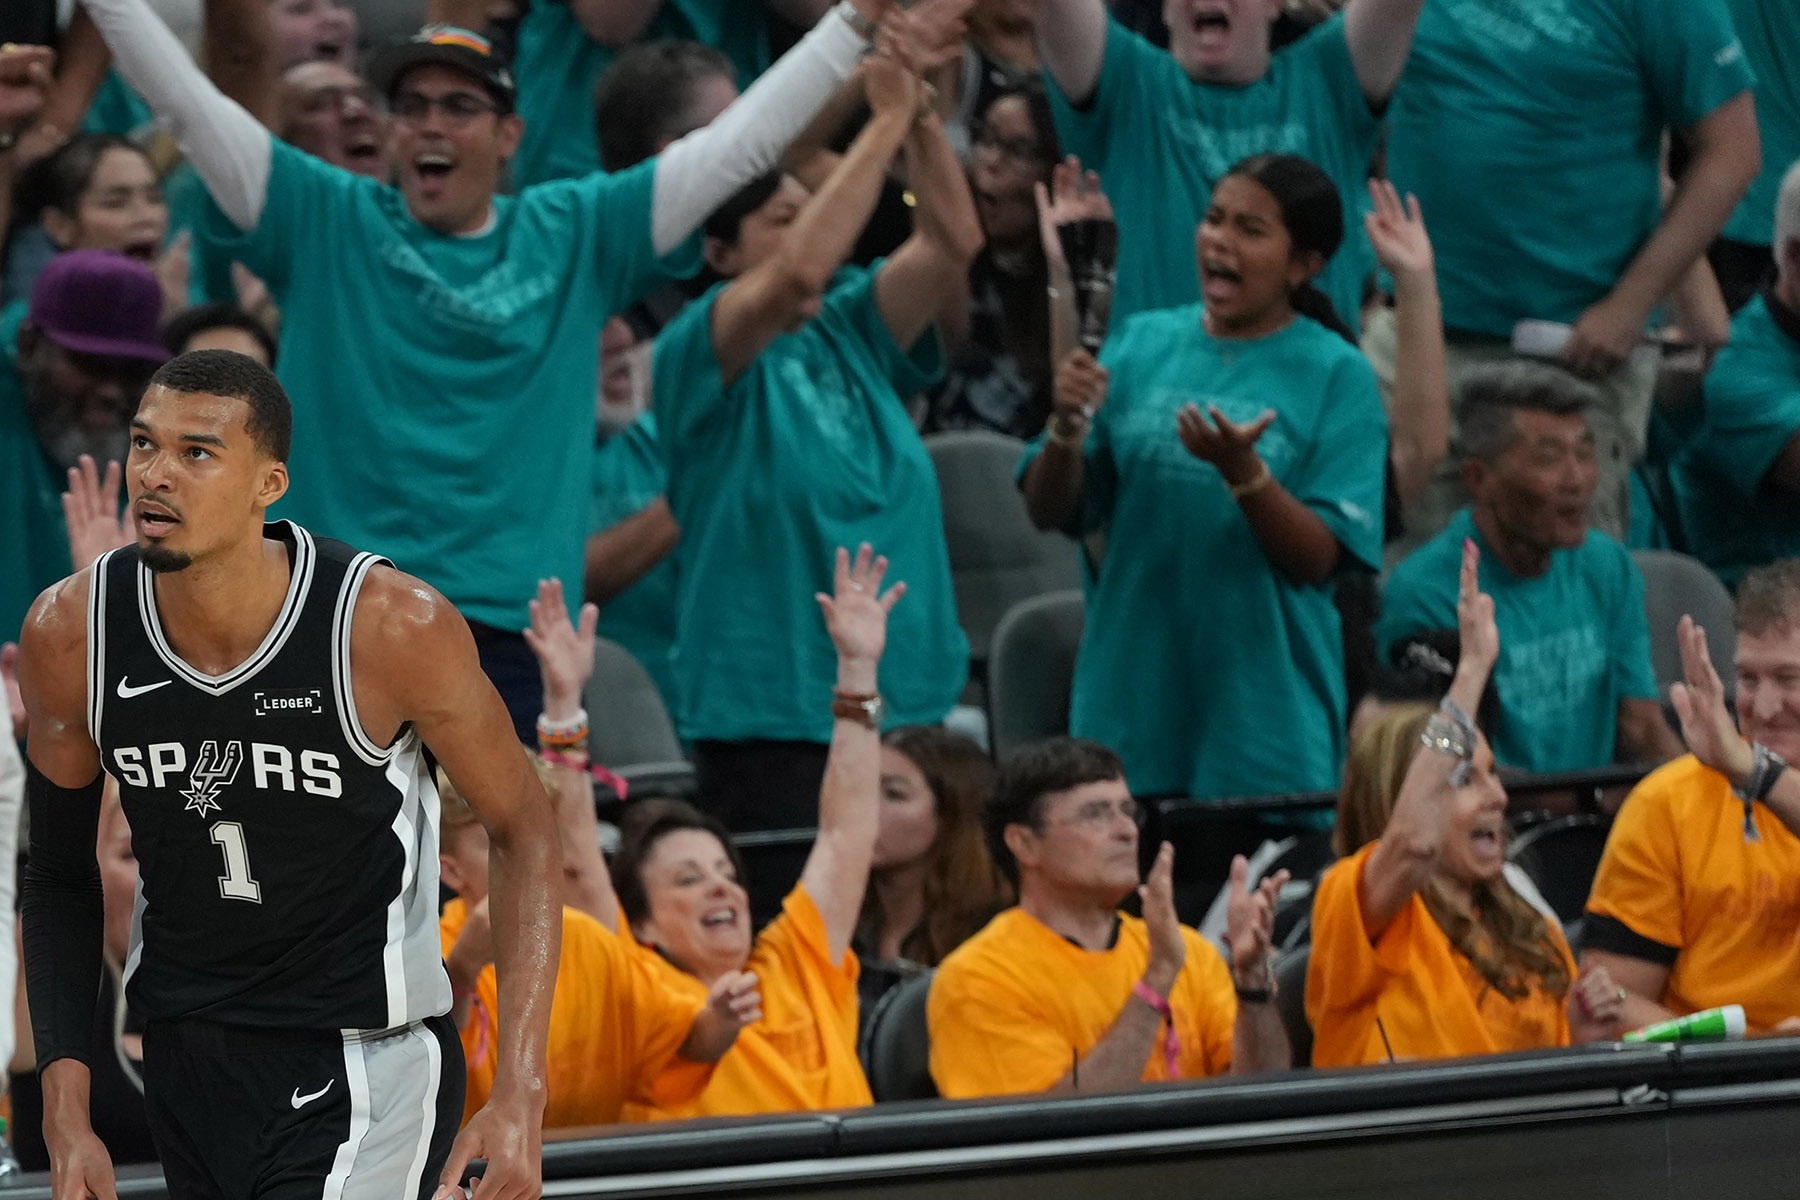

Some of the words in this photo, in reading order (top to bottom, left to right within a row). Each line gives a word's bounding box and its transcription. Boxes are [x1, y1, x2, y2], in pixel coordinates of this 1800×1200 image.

[263, 697, 313, 710] LEDGER
[113, 741, 343, 818] SPURS
[209, 821, 262, 904] 1
